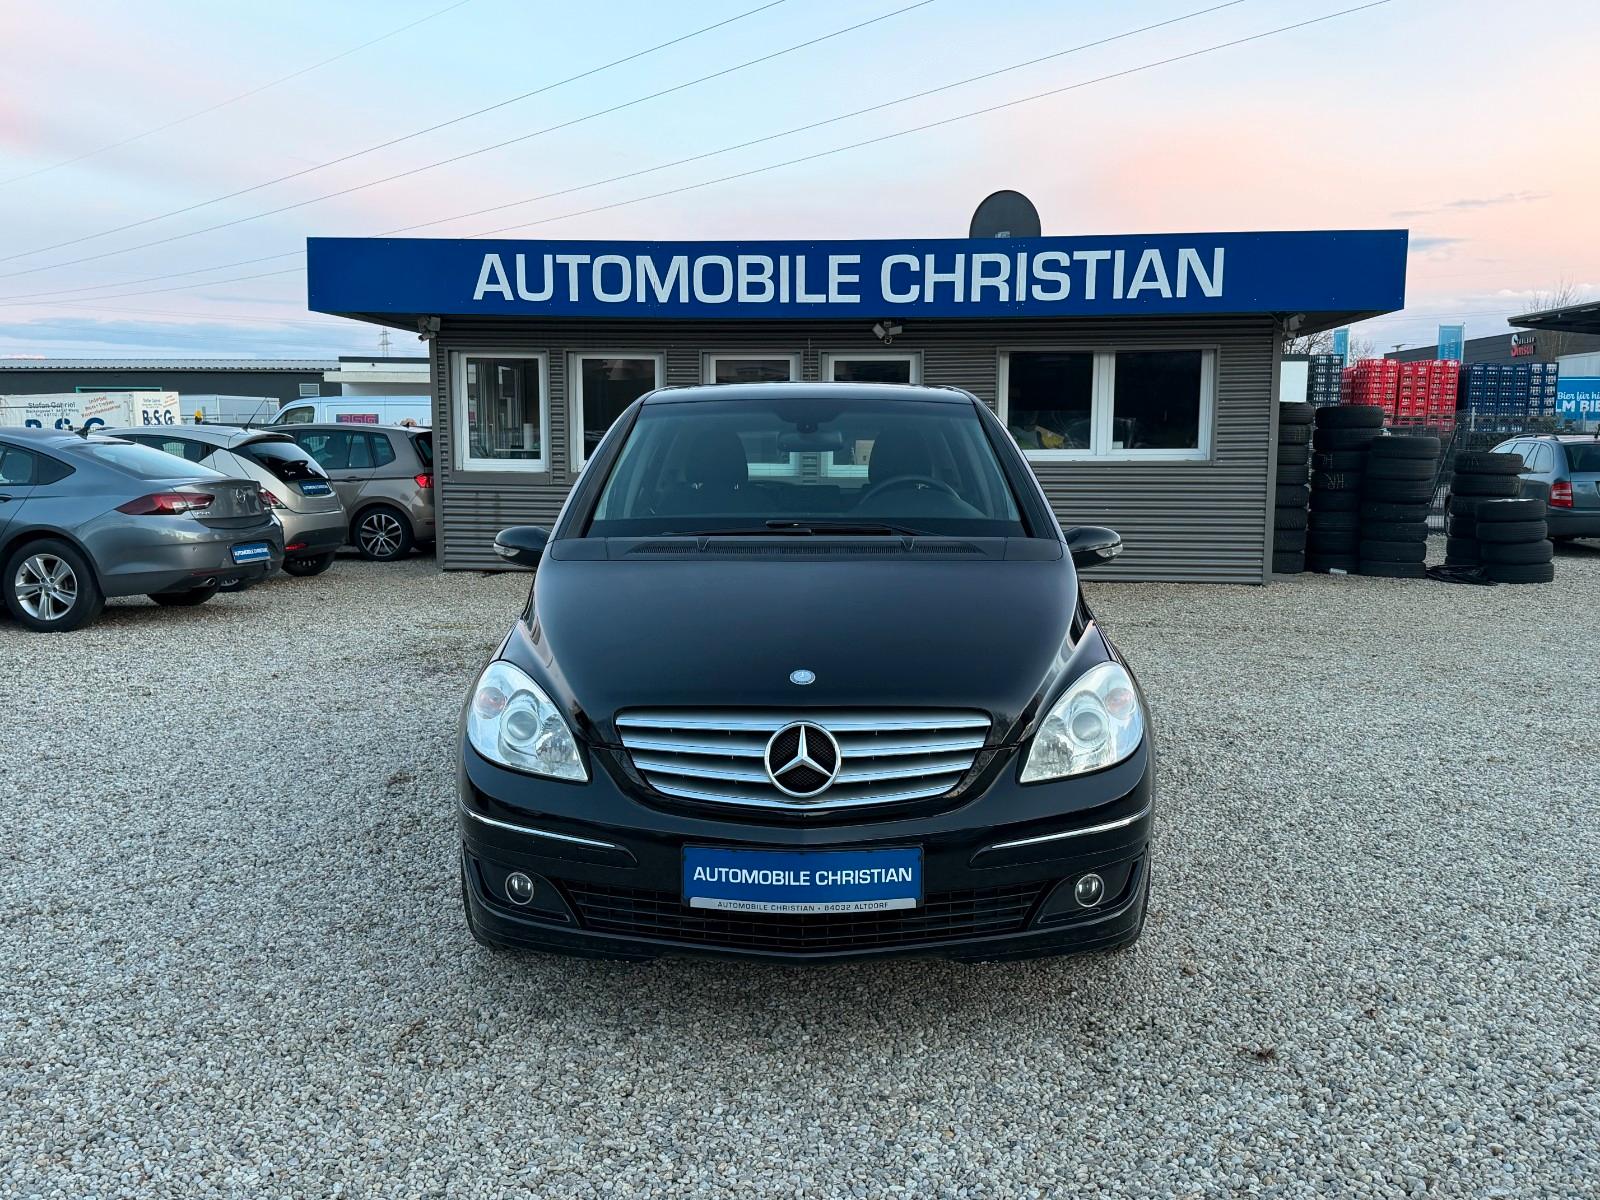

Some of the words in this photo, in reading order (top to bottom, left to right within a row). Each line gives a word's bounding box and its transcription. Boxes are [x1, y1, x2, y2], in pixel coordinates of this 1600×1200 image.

[472, 253, 861, 304] AUTOMOBILE
[880, 247, 1225, 304] CHRISTIAN
[1557, 391, 1575, 400] Bier
[1576, 391, 1590, 402] für
[693, 866, 811, 886] AUTOMOBILE
[815, 867, 912, 886] CHRISTIAN
[717, 901, 768, 911] AUTOMOBILE
[770, 904, 815, 912] CHRISTIAN
[824, 904, 851, 912] 84032
[854, 902, 889, 910] ALTDORF
